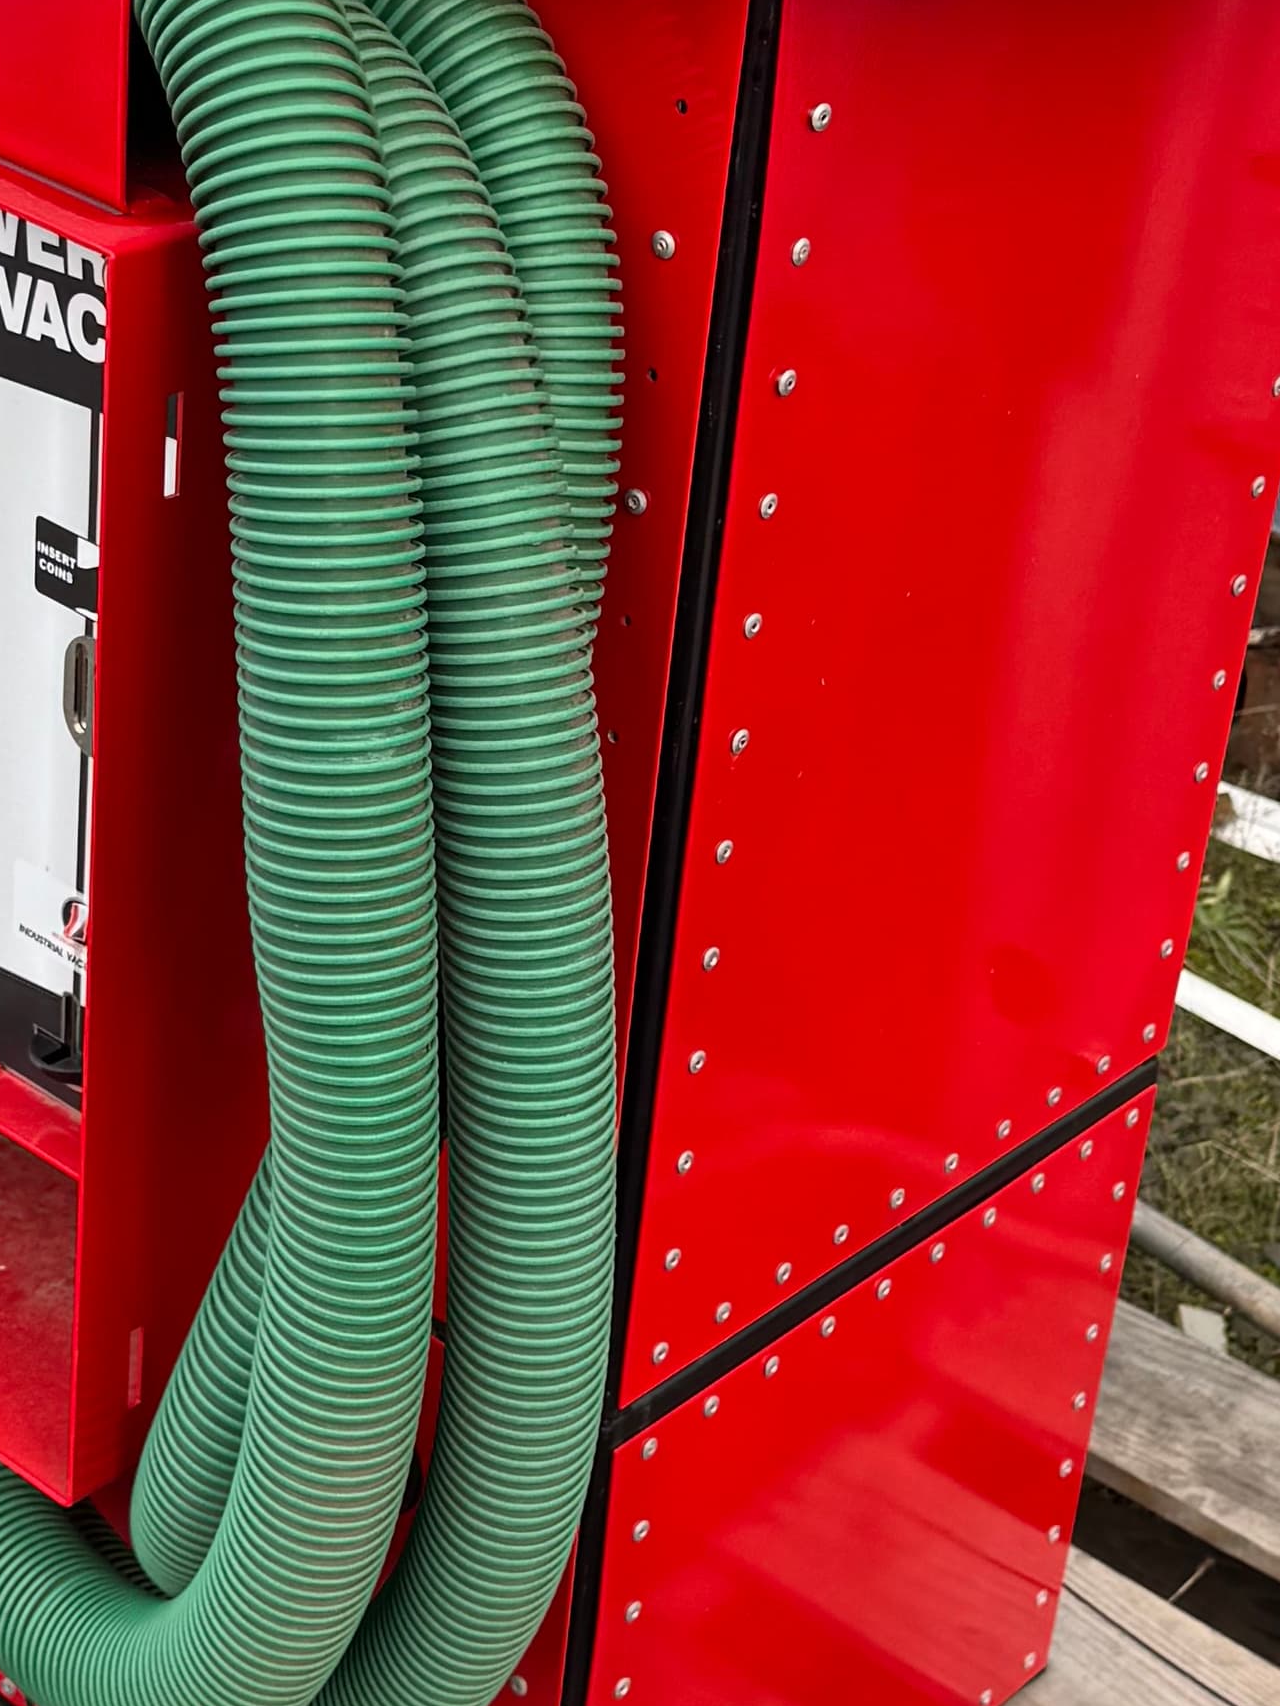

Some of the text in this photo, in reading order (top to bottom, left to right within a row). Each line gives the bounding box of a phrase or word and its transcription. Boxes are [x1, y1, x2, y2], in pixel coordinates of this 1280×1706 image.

[37, 540, 77, 570] INSERT
[39, 558, 74, 585] COINS
[18, 923, 64, 958] INDUSTRIAL
